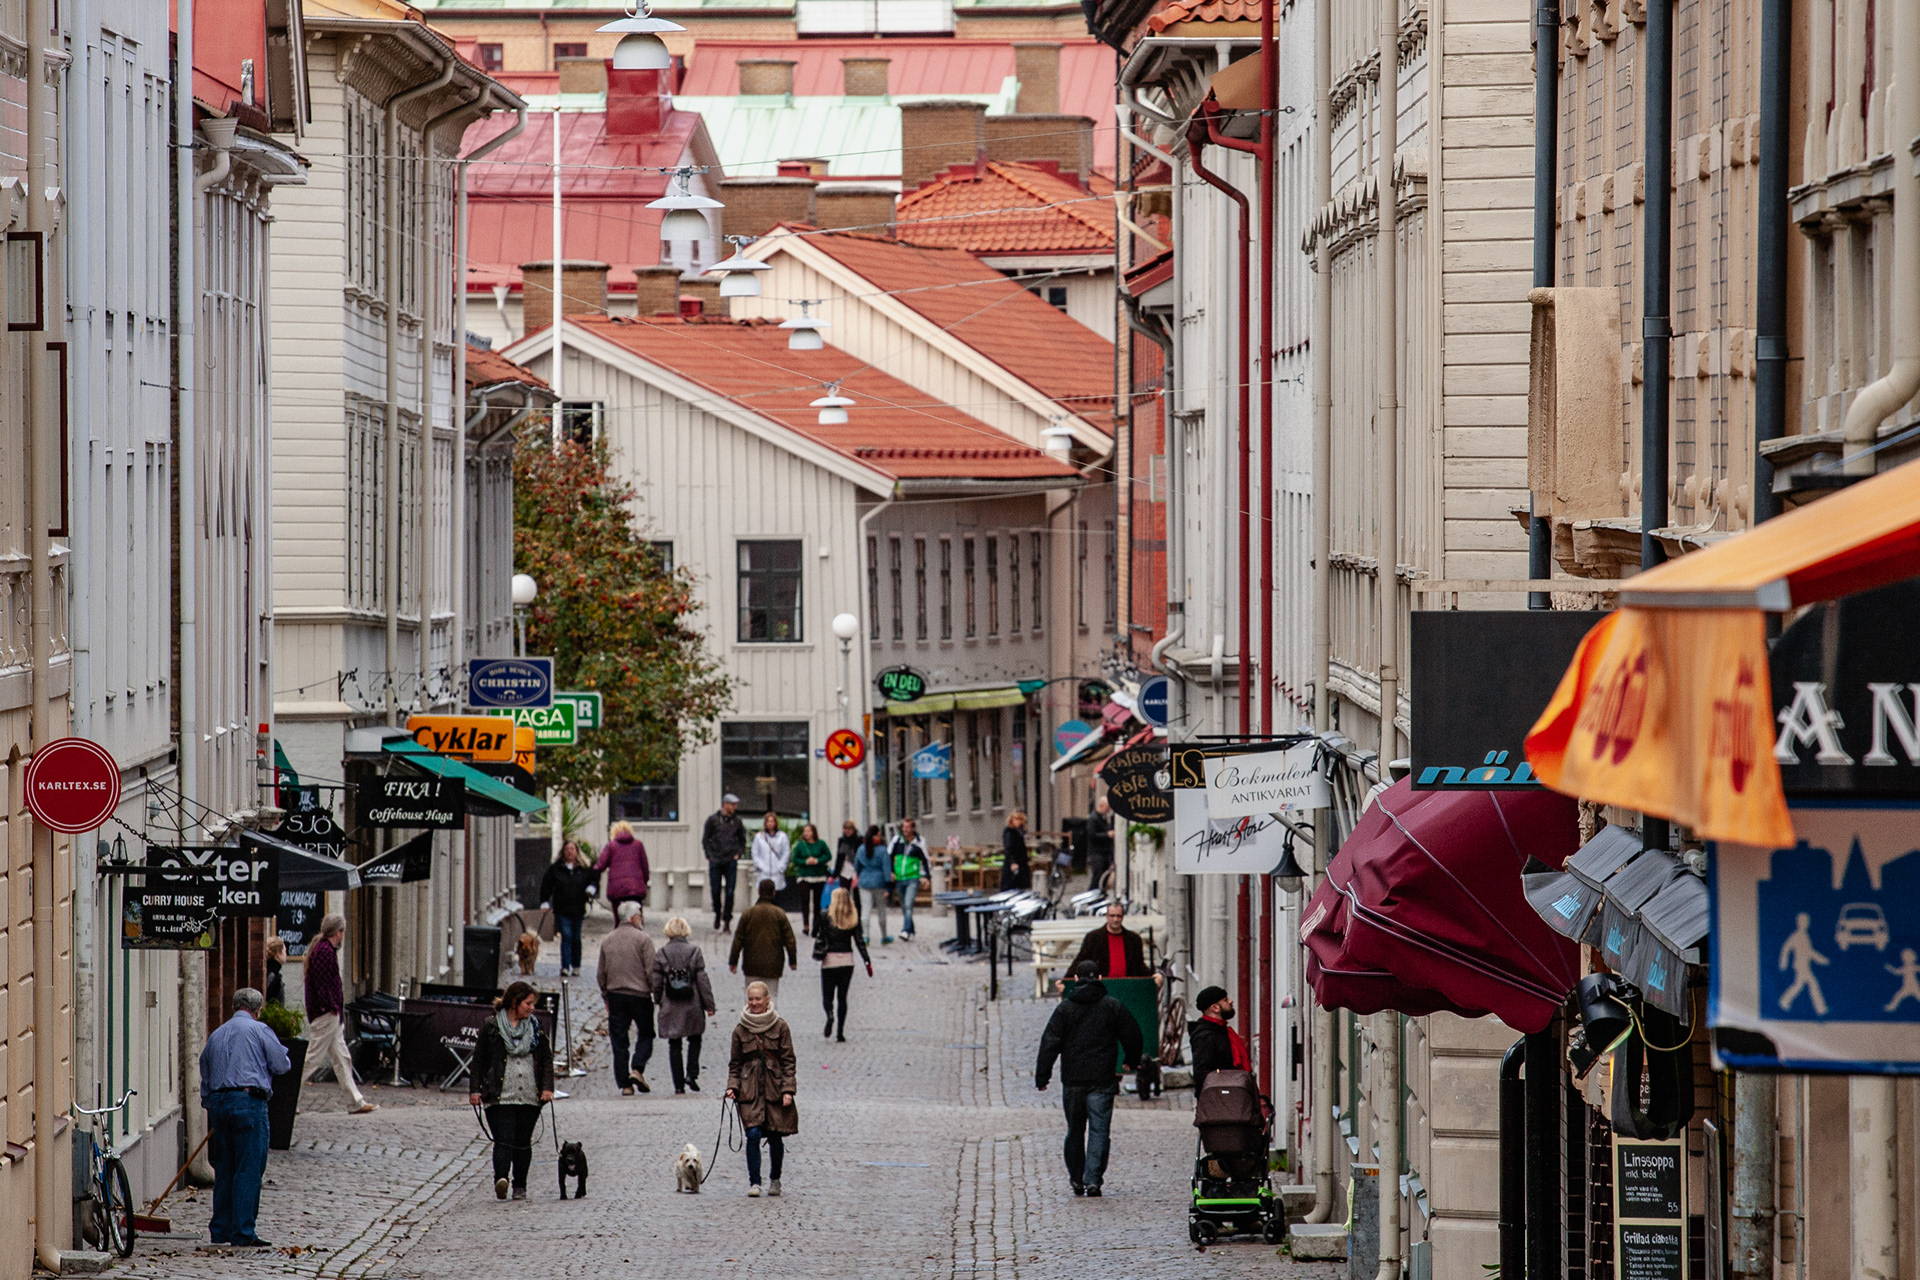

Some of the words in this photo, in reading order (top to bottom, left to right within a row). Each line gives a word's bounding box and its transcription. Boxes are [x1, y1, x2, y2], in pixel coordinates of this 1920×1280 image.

[479, 679, 541, 687] CHRISTIN
[413, 726, 508, 753] Cyklar
[1214, 762, 1311, 789] Bokmalen
[1417, 750, 1544, 784] nöl
[38, 781, 107, 790] KARLTEX.SE
[384, 782, 430, 799] FIKA
[435, 782, 441, 797] !
[1231, 785, 1312, 804] ANTIKVARIAT
[369, 807, 424, 823] Coffehouse
[425, 809, 454, 824] Haga
[286, 814, 332, 835] SJÖ
[142, 895, 172, 906] CURRY
[174, 895, 205, 907] HOUSE
[218, 885, 260, 904] ken
[1624, 1152, 1674, 1170] Linssoppa
[1641, 1170, 1657, 1179] bröd
[1624, 1231, 1650, 1244] Grillad
